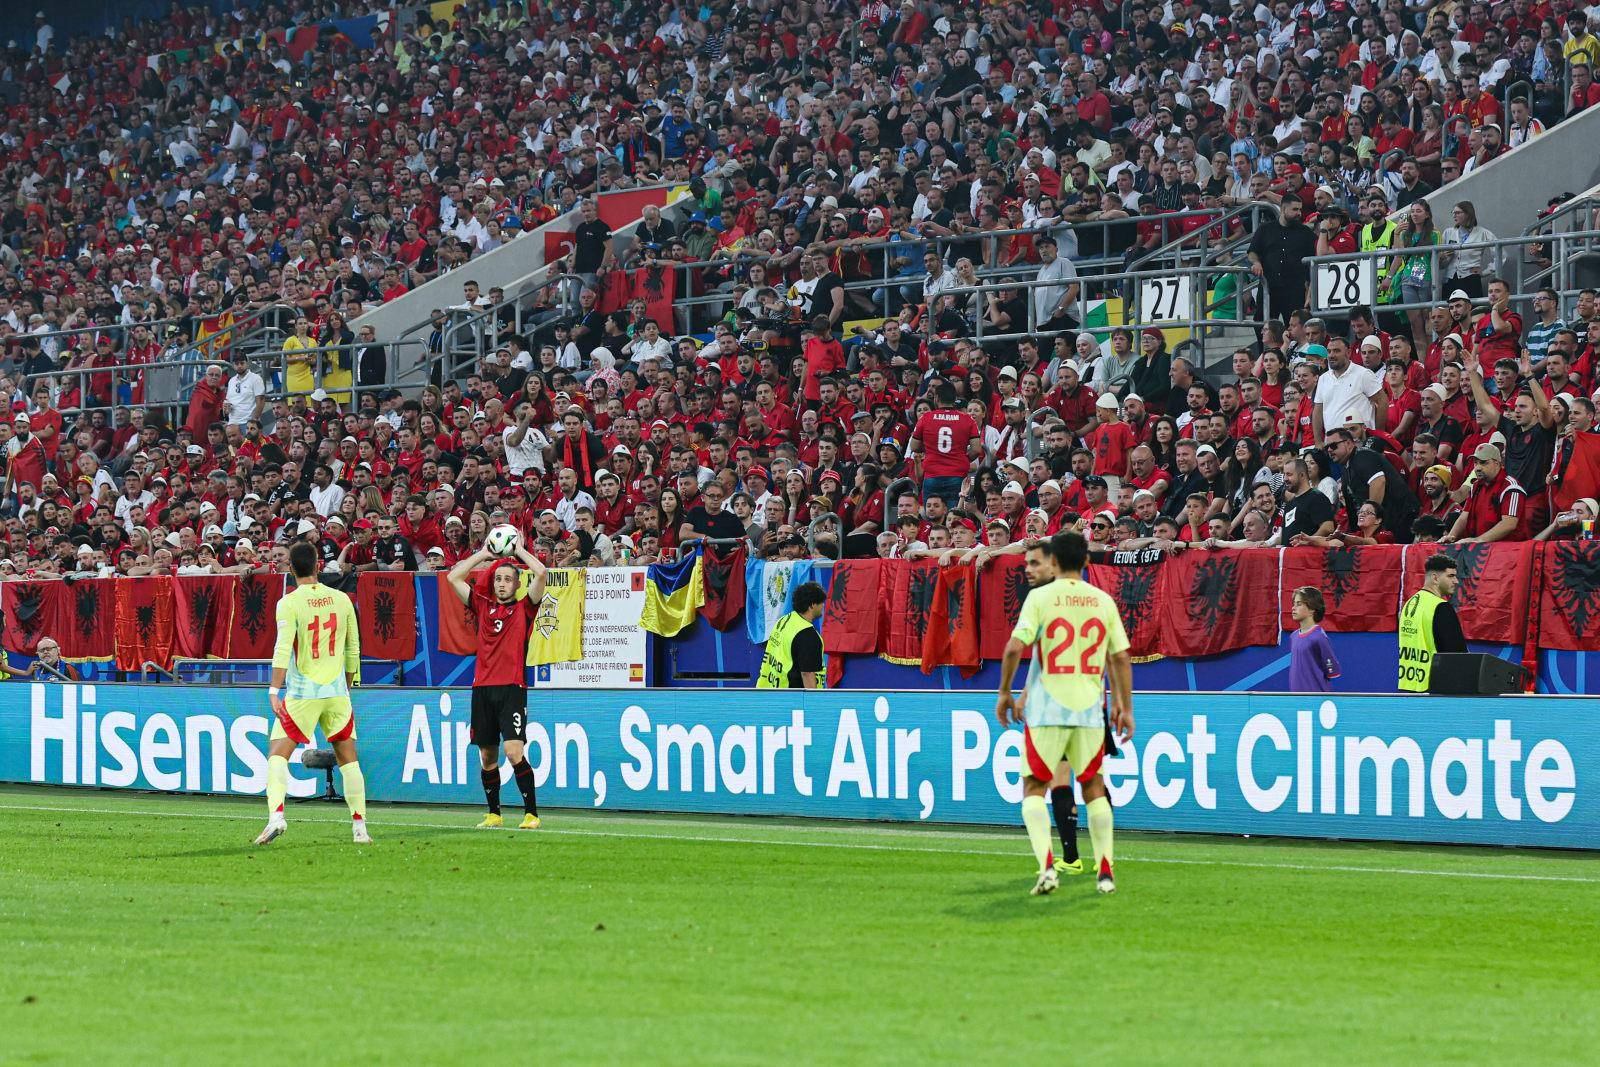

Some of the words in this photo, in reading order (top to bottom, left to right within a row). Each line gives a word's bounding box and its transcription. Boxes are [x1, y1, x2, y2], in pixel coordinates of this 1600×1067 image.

[1328, 263, 1361, 304] 28
[1151, 279, 1180, 319] 27
[937, 426, 953, 454] 6
[592, 573, 609, 584] LOVE
[612, 573, 625, 584] YOU
[585, 590, 599, 600] EED
[599, 589, 604, 599] 3
[605, 589, 630, 600] POINTS
[1065, 595, 1100, 608] NAVAS
[493, 619, 503, 633] 3
[580, 625, 599, 633] SOVO'S
[307, 612, 338, 659] 11
[588, 637, 602, 646] LOSE
[1046, 617, 1106, 675] 22
[553, 662, 565, 671] YOU
[565, 662, 577, 671] WILL
[577, 662, 591, 671] GAIN
[596, 662, 608, 671] TRUE
[609, 662, 628, 671] FRIEND
[578, 675, 602, 683] RESPECT
[512, 712, 522, 727] 3
[620, 705, 813, 800] Smart
[825, 696, 935, 822] Air,
[951, 709, 1218, 811] Peect
[1236, 700, 1577, 825] Climate
